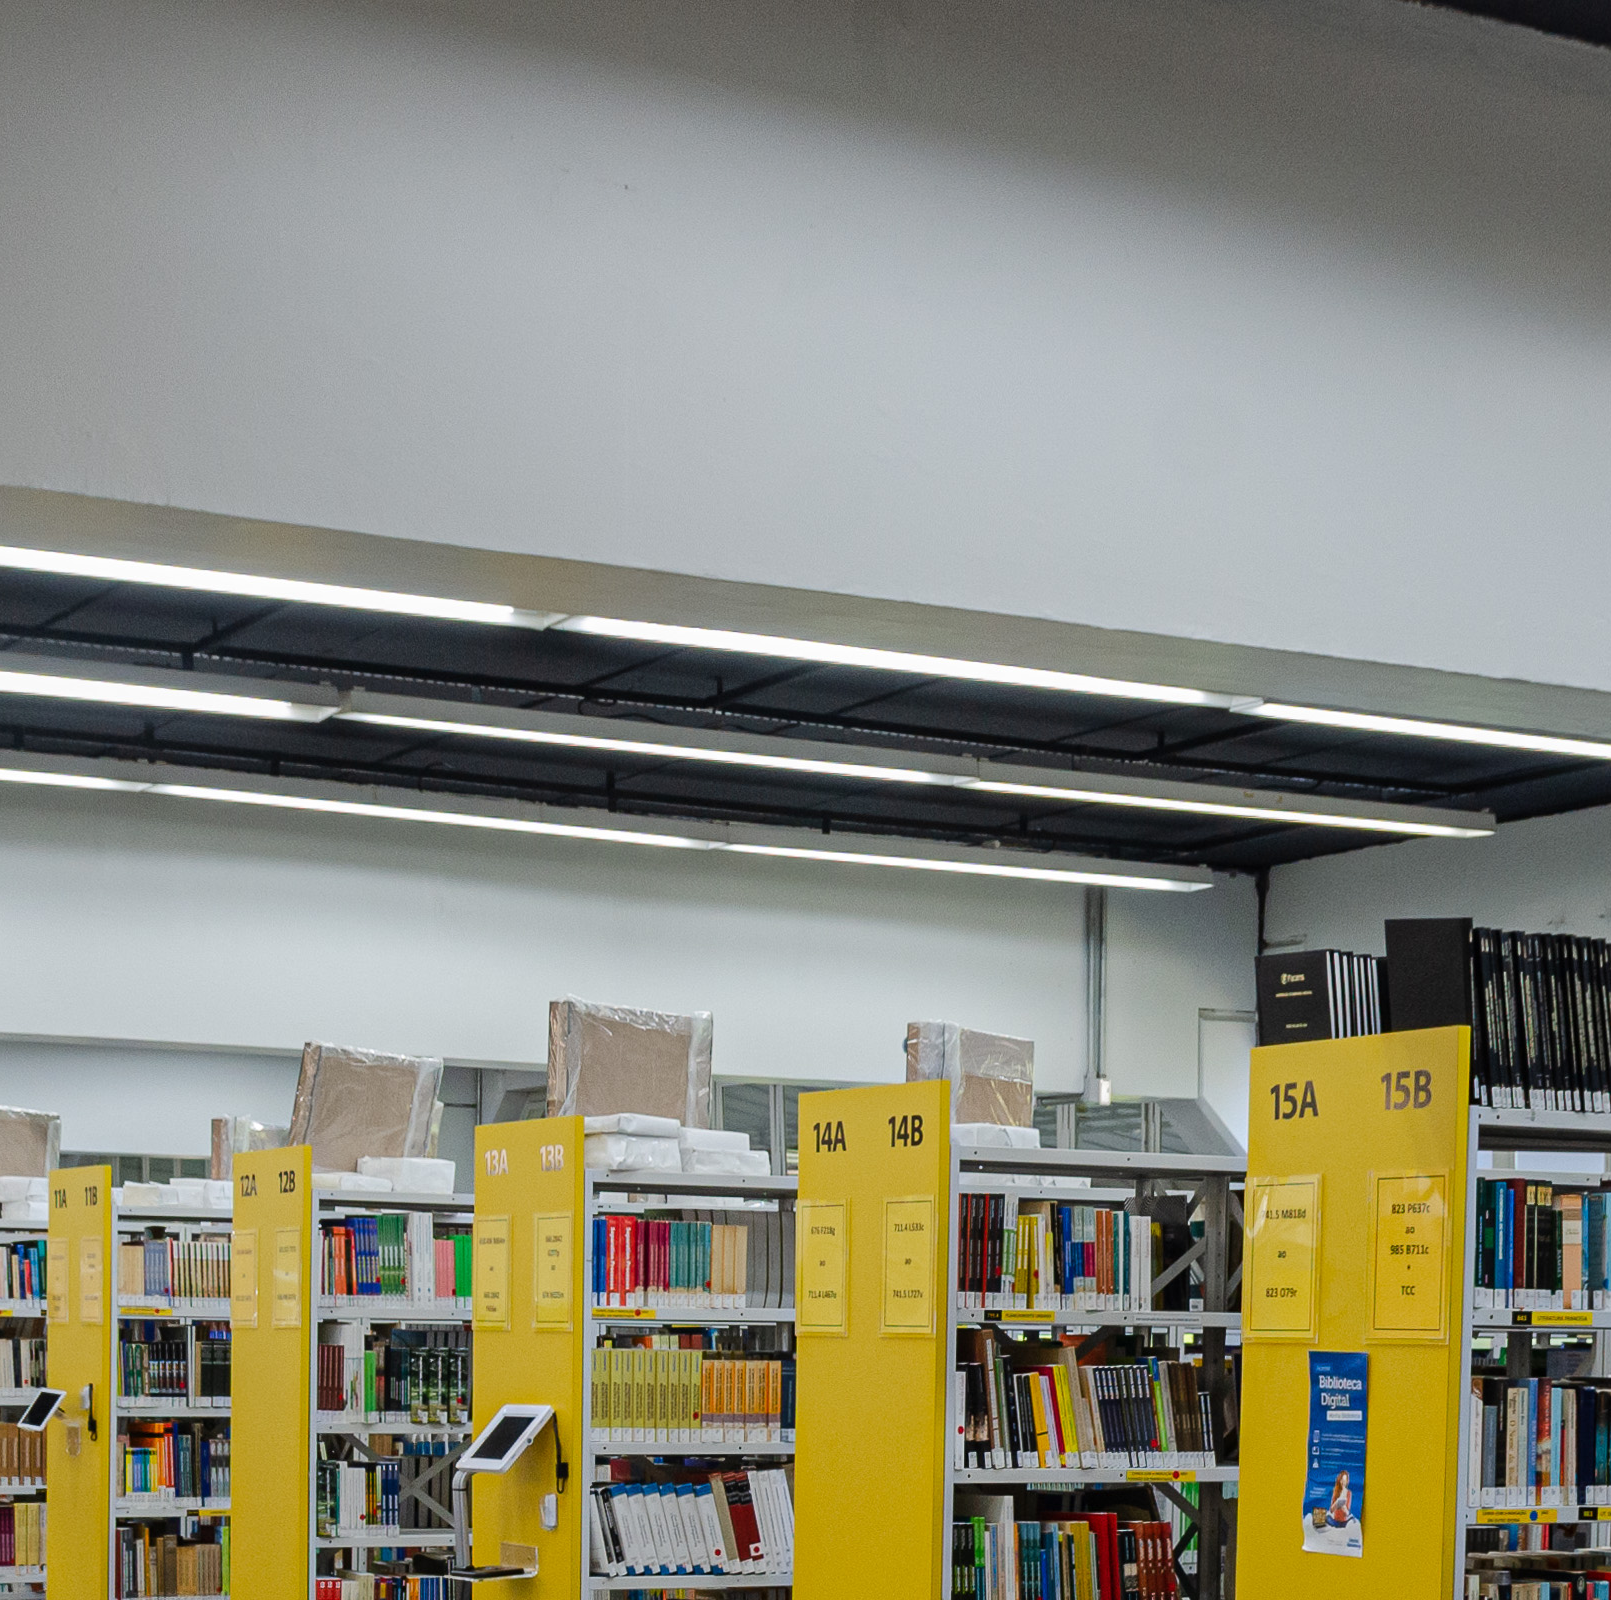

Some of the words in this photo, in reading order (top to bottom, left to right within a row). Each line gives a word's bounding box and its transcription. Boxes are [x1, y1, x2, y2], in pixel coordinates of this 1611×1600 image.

[1380, 1070, 1432, 1110] 15B
[1270, 1080, 1319, 1120] 15A
[813, 1121, 847, 1152] 14A
[888, 1115, 924, 1147] 14B
[484, 1149, 509, 1176] 13A
[539, 1144, 564, 1171] 13B
[240, 1173, 257, 1197] 12A
[278, 1170, 296, 1194] 12B
[54, 1189, 67, 1208] 11A
[85, 1186, 98, 1206] 11B
[1391, 1203, 1405, 1213] 823
[1408, 1203, 1430, 1213] P637c
[1405, 1226, 1415, 1234] ao
[1278, 1250, 1286, 1258] ao
[1390, 1245, 1404, 1254] 985
[1265, 1288, 1278, 1297] 823
[1401, 1286, 1415, 1295] TCC
[1319, 1375, 1362, 1390] Biblioteca
[1321, 1392, 1350, 1409] Digital
